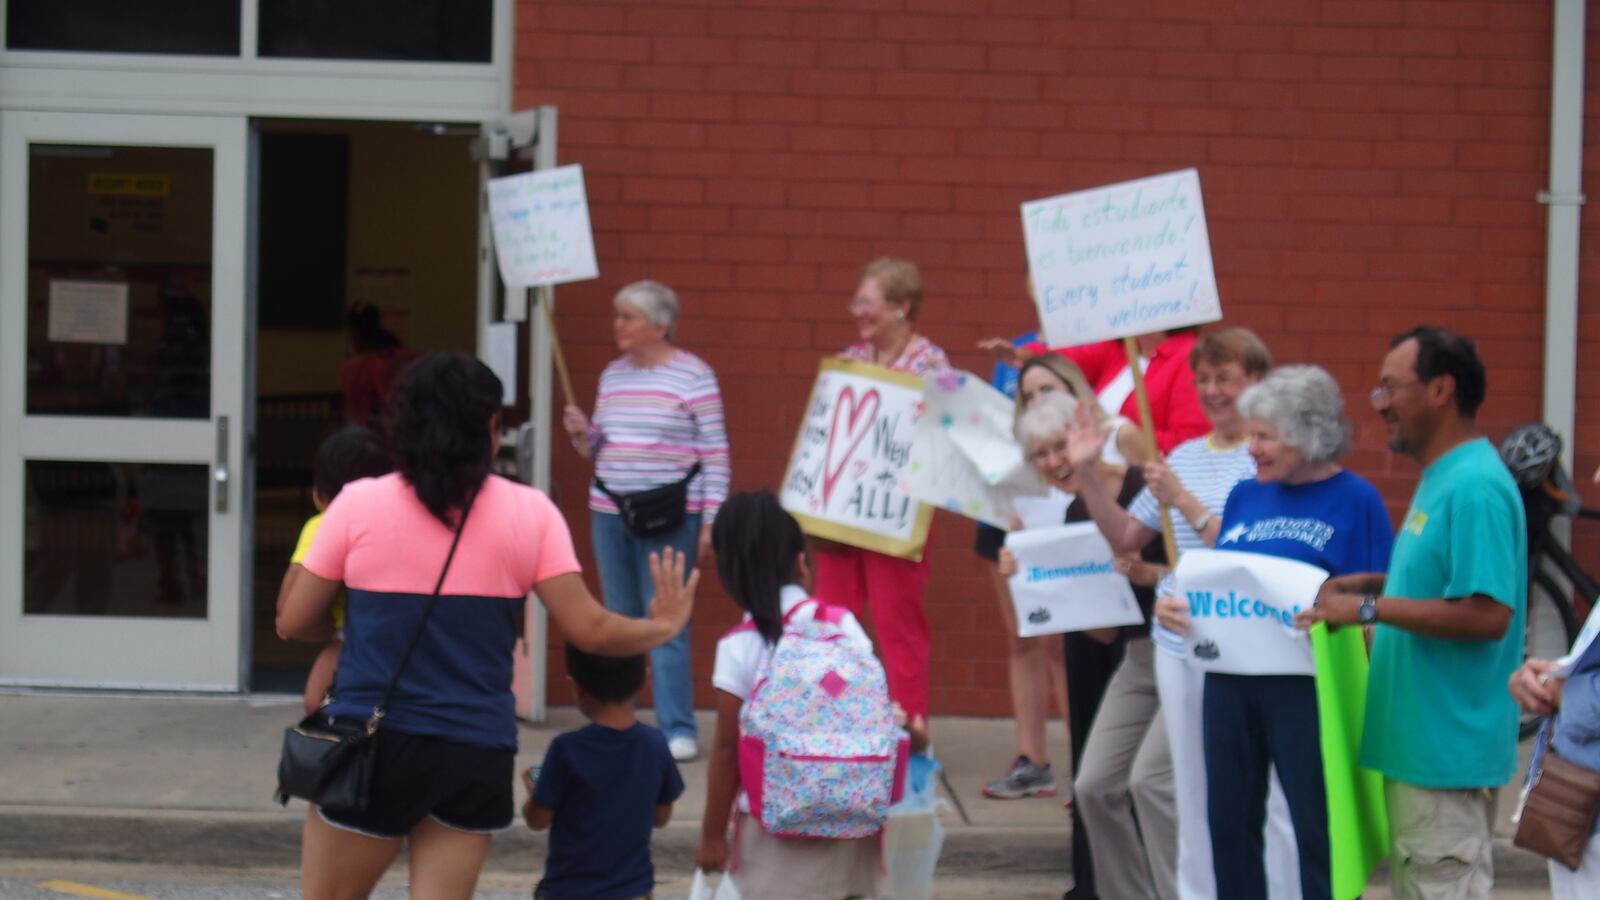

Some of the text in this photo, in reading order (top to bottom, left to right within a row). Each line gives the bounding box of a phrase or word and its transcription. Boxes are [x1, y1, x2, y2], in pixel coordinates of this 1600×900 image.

[1044, 252, 1188, 314] Every student
[841, 482, 911, 530] ALL!
